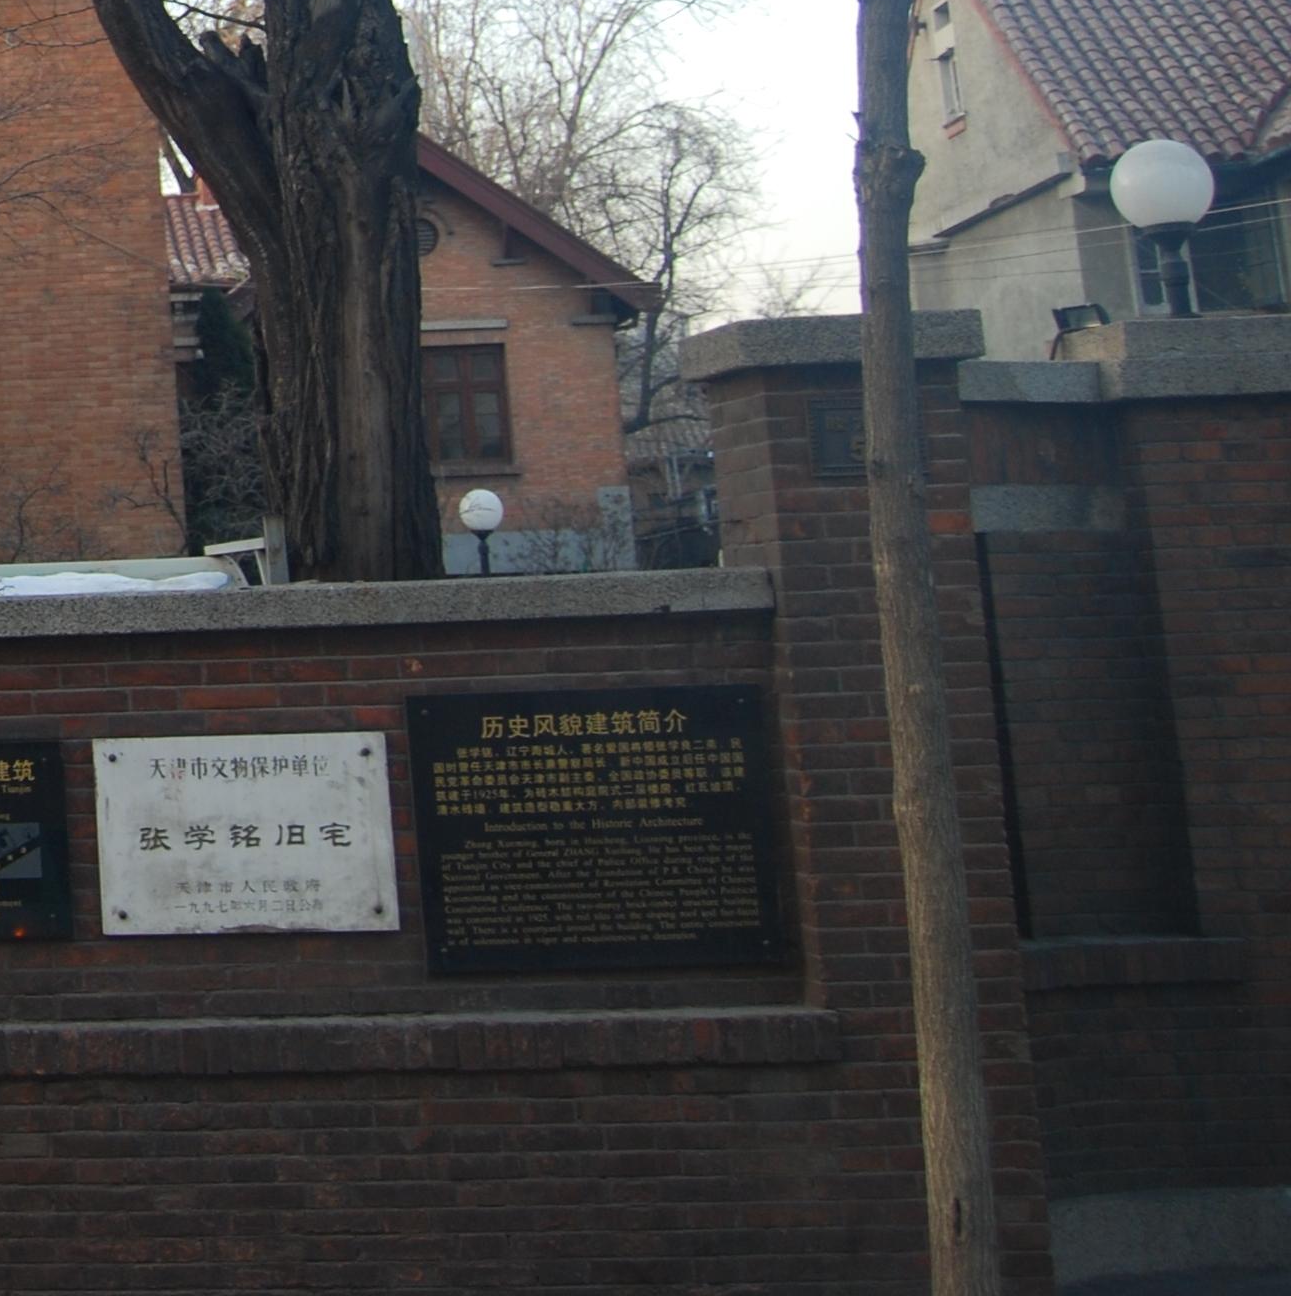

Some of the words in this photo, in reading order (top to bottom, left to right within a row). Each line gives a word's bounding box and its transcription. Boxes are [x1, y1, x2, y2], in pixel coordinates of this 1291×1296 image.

[481, 709, 688, 738] 历史风貌建筑简介
[1, 784, 32, 796] Tianjin
[483, 821, 548, 832] Introduction
[552, 821, 564, 829] to
[569, 819, 586, 830] the
[591, 818, 633, 829] Historic
[638, 816, 704, 828] Architecture
[139, 823, 352, 851] 张学铭旧宅
[176, 879, 321, 895] 天津市人民政府
